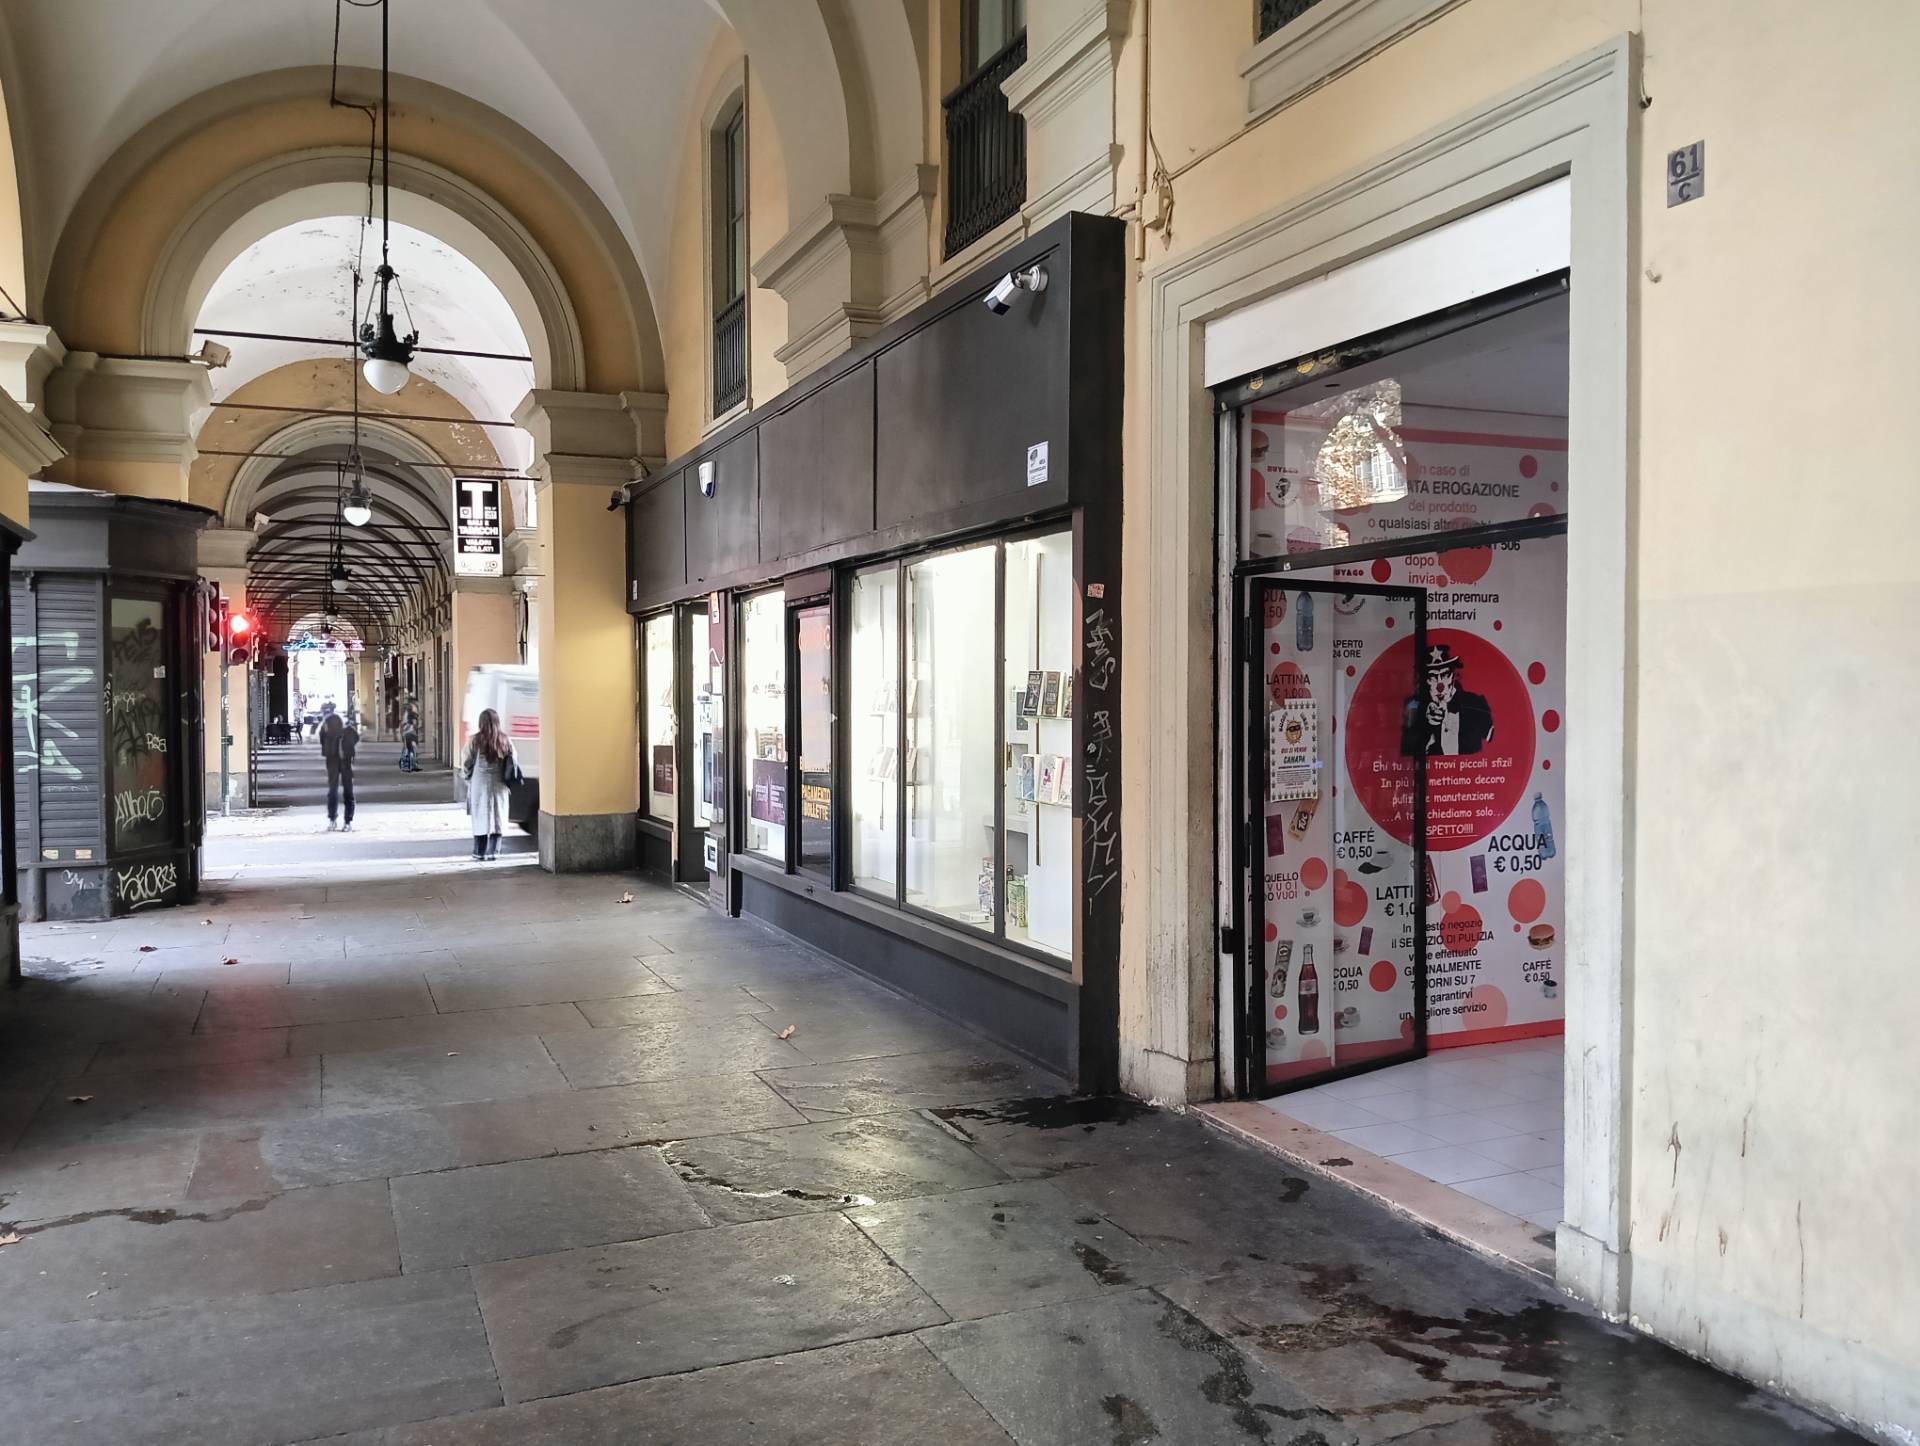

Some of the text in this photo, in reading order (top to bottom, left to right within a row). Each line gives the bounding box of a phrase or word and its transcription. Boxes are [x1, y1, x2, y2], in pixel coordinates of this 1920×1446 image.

[1671, 144, 1699, 178] 61
[1679, 182, 1691, 201] C
[1433, 481, 1520, 498] EROGAZIONE
[462, 482, 493, 519] T
[1408, 501, 1424, 512] del
[459, 526, 499, 536] TABACCHI
[1379, 518, 1430, 531] qualsiasi
[1405, 553, 1434, 568] dopo
[1452, 593, 1499, 605] premura
[1344, 649, 1361, 658] ORE
[1266, 673, 1311, 686] LATTINA
[1434, 760, 1456, 769] trovi
[1459, 758, 1488, 771] piccoli
[1428, 774, 1505, 787] mettiamo decoro
[1433, 791, 1495, 803] manutenzione
[1427, 808, 1472, 819] chiediamo
[1488, 834, 1548, 853] ACQUA
[1348, 846, 1373, 860] 0,50
[1493, 855, 1542, 874] € 0,50
[1384, 903, 1395, 917] €
[1402, 923, 1412, 933] In
[1448, 920, 1483, 932] negozio
[1458, 930, 1494, 943] PULIZIA
[1434, 948, 1478, 959] effettuato
[1333, 966, 1363, 979] CQUA
[1454, 975, 1468, 986] SU
[1470, 974, 1476, 985] 7
[1430, 988, 1473, 1005] garantirvi
[1452, 1003, 1487, 1015] servizio
